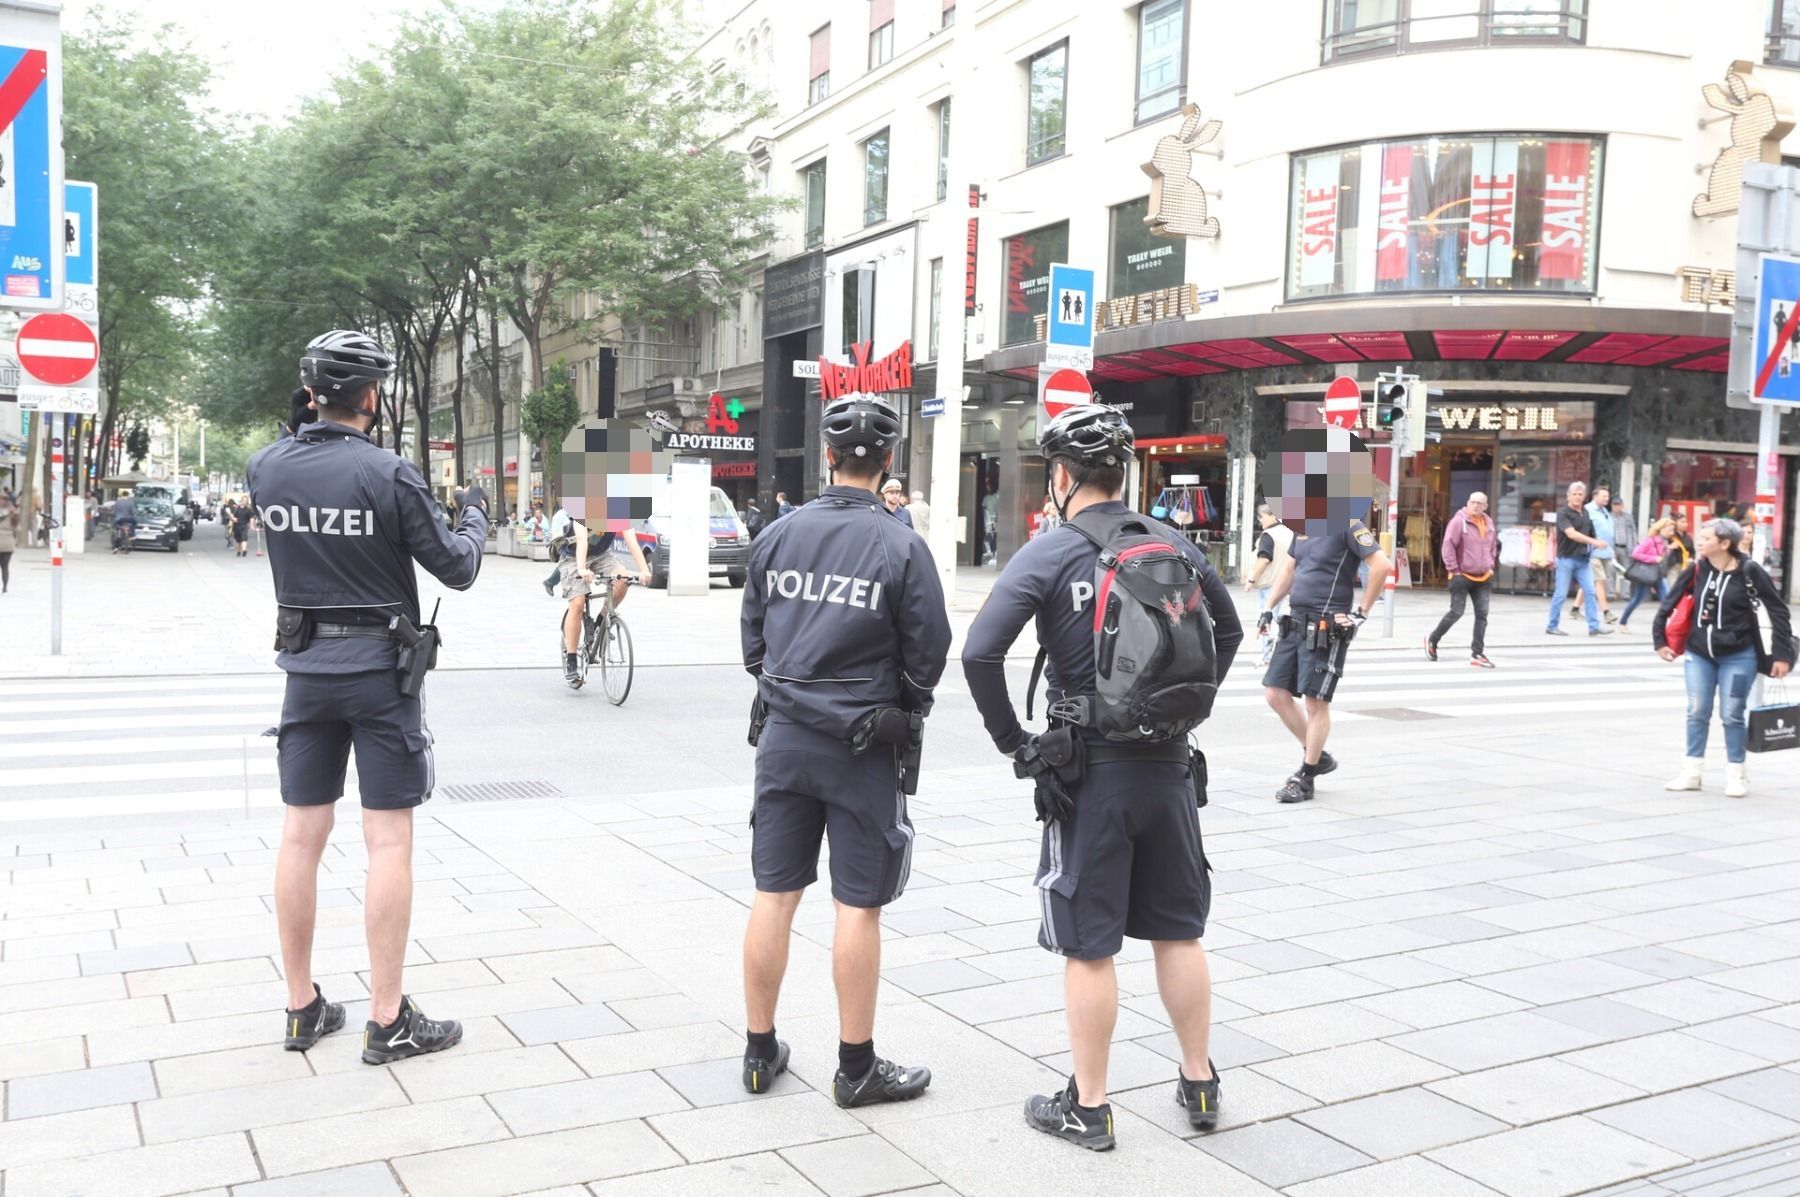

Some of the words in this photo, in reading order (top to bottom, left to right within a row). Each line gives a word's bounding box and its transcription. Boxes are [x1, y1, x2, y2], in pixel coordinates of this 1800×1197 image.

[1304, 185, 1337, 256] SALE
[1379, 176, 1409, 249] SALE
[1470, 174, 1514, 246] SALE
[1542, 174, 1585, 248] SALE
[667, 433, 755, 452] APOTHEKE
[256, 504, 374, 537] OLIZEI
[766, 569, 881, 611] POLIZEI
